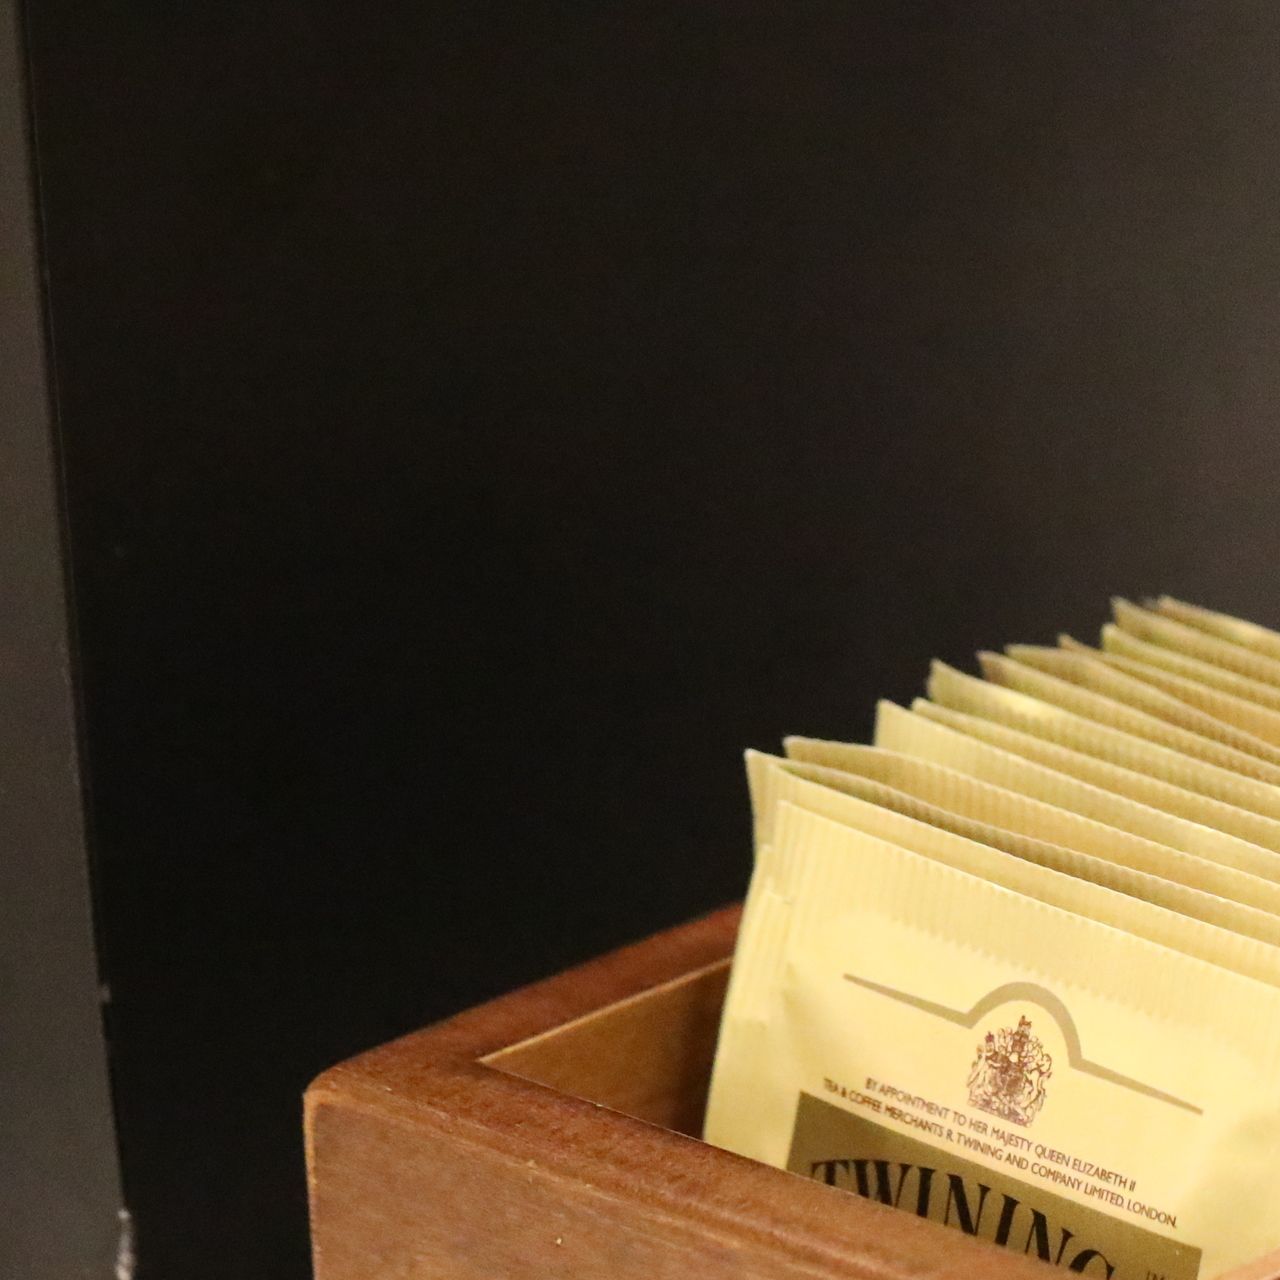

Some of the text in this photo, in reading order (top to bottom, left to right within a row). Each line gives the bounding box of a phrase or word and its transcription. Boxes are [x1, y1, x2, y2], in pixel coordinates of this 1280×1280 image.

[850, 1090, 882, 1113] COFFEE
[884, 1105, 944, 1138] MERCHANTS
[957, 1132, 1005, 1161] TWINING
[1005, 1153, 1029, 1170] AND
[1031, 1162, 1083, 1190] COMPANY
[879, 1085, 950, 1119] APPOINTMENT
[952, 1111, 967, 1126] TO
[968, 1118, 989, 1135] HER
[990, 1127, 1033, 1152] MAJESTY
[1035, 1144, 1071, 1167] QUEEN
[1072, 1158, 1128, 1189] ELIZABETH
